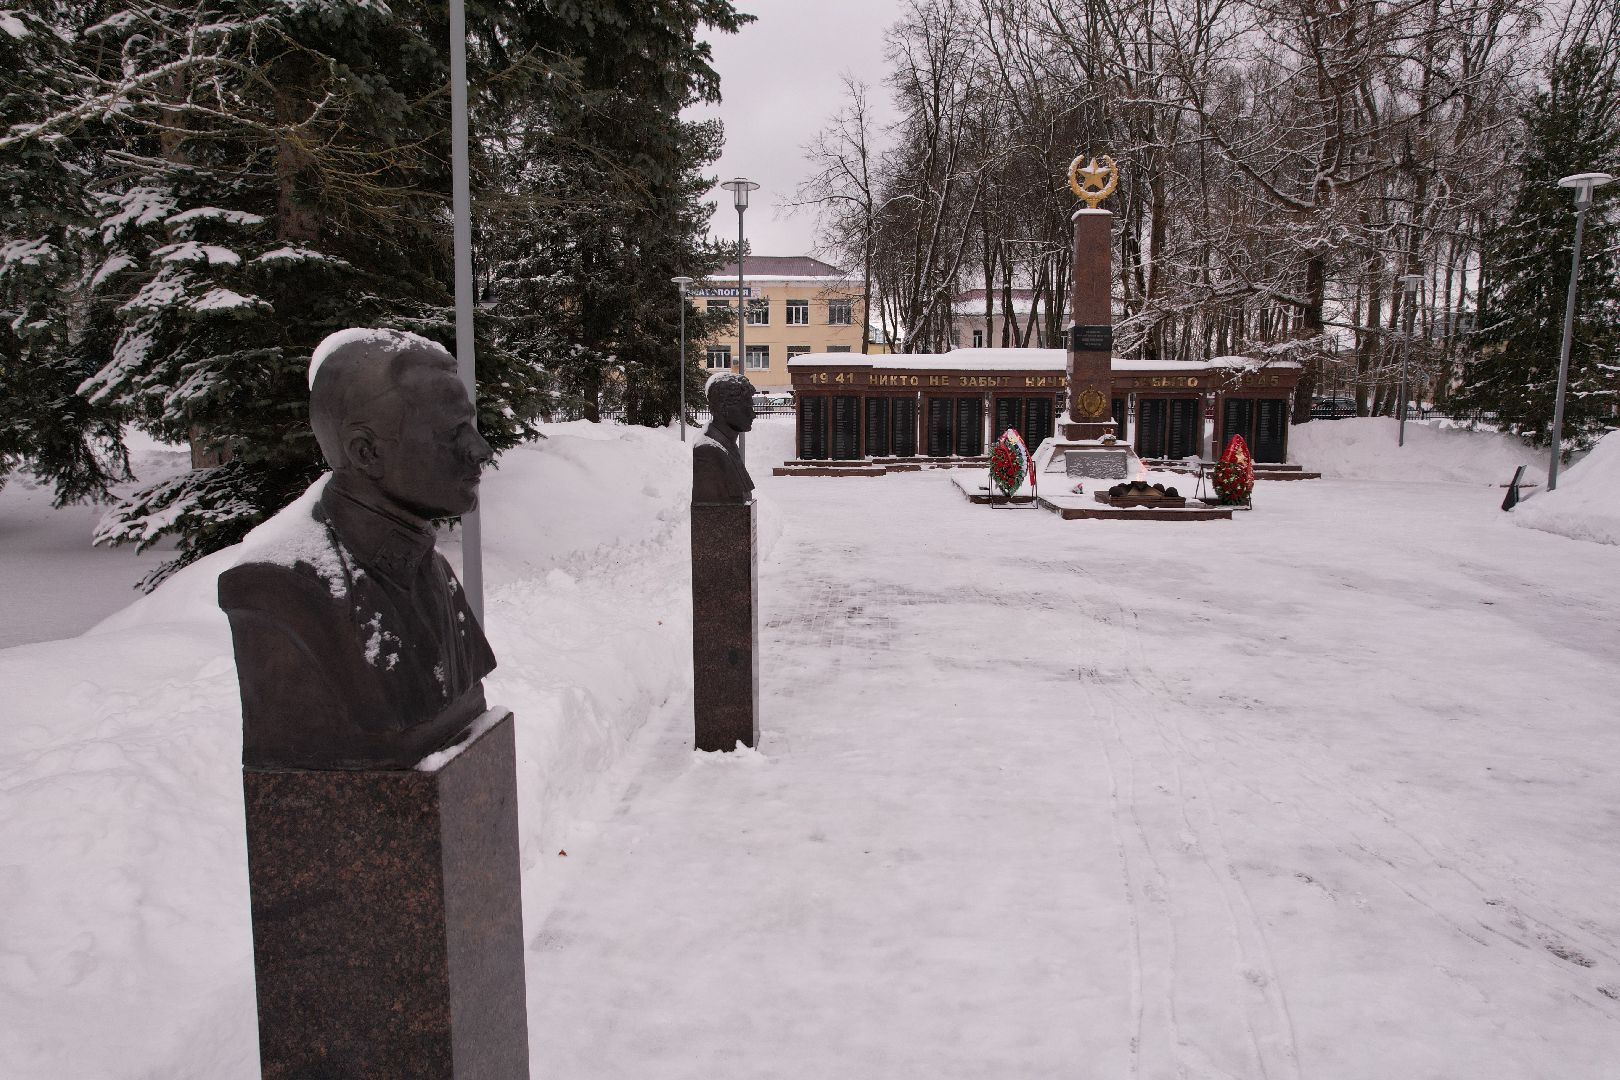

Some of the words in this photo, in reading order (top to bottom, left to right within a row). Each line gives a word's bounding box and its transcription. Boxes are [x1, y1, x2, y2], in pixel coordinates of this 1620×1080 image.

[869, 375, 919, 386] НИКТО
[929, 375, 950, 386] НЕ
[959, 376, 1011, 387] ЗАБЫТ
[1025, 377, 1067, 387] НИЧТ
